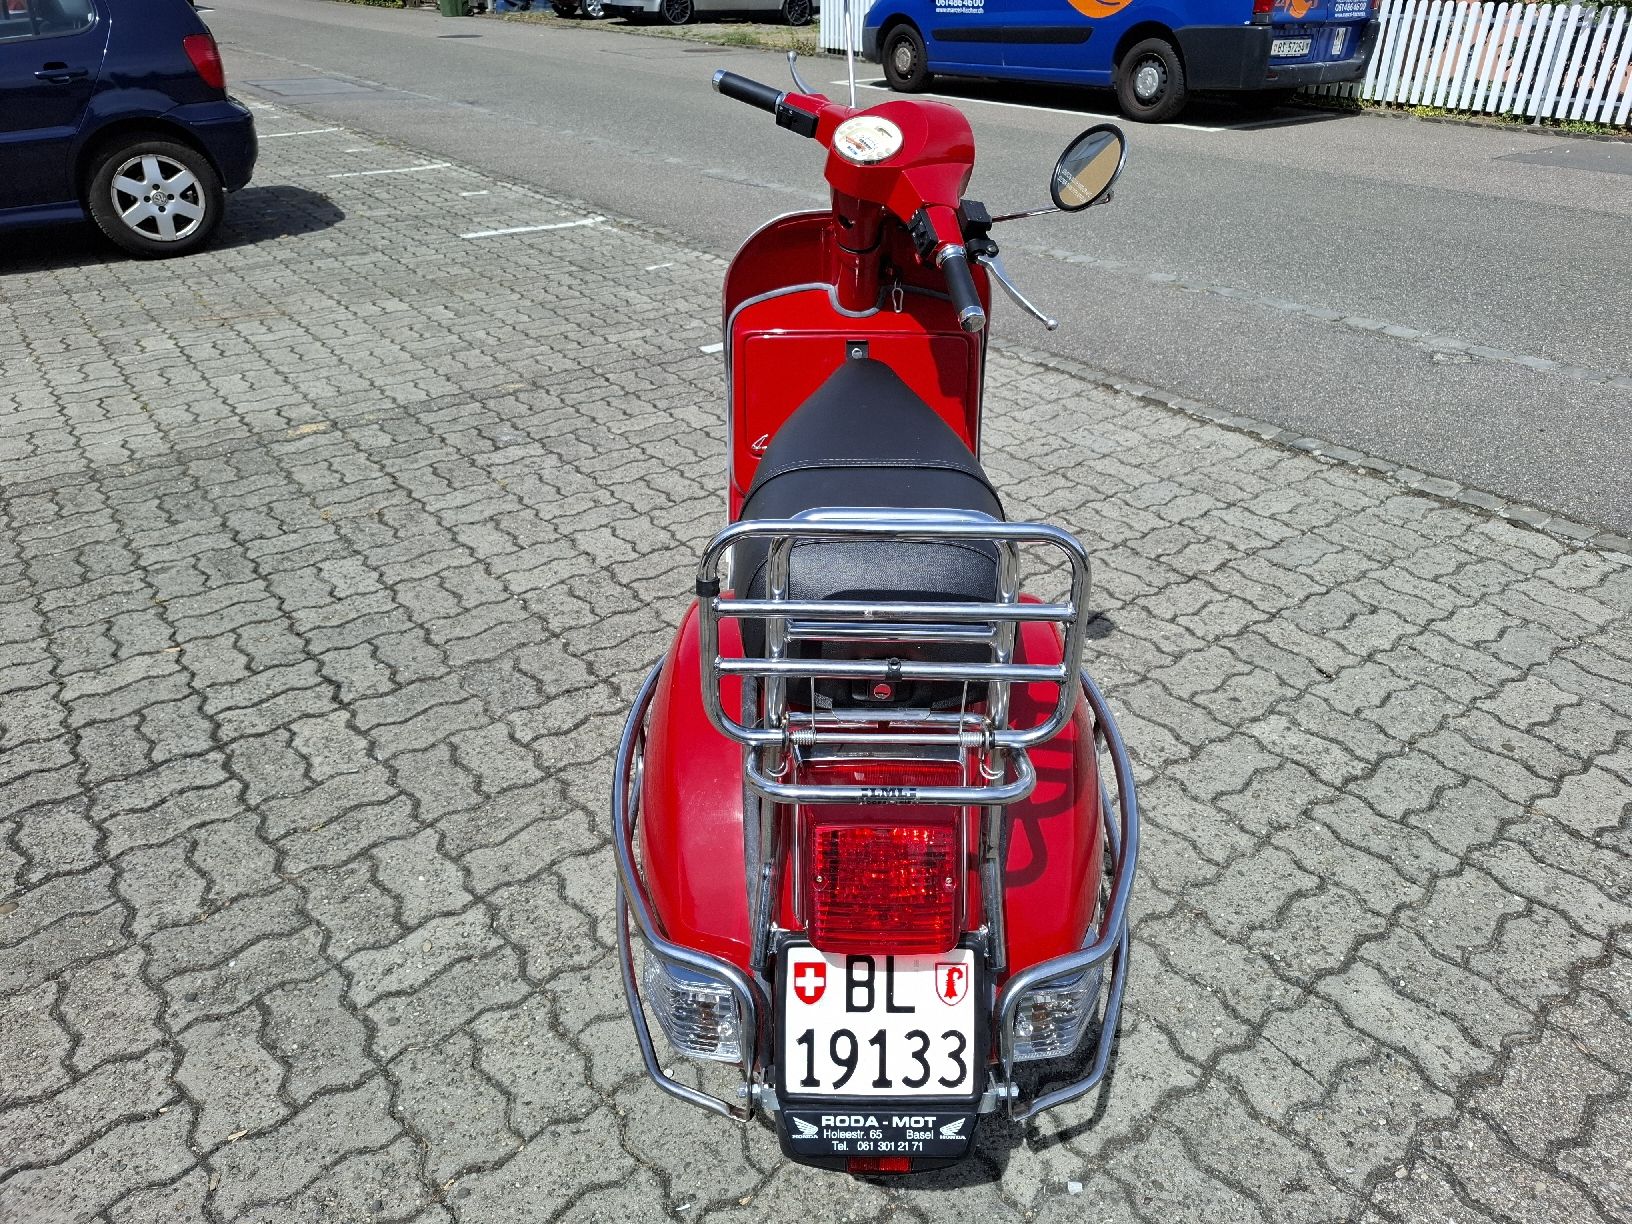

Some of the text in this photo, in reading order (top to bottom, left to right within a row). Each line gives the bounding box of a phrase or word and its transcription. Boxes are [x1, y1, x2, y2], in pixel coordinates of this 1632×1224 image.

[870, 787, 908, 797] LML
[845, 954, 915, 1013] BL
[796, 1028, 967, 1090] 19133
[821, 1115, 879, 1127] RODA
[892, 1116, 937, 1128] MOT
[823, 1128, 934, 1140] Holeestr. 65 Basel
[831, 1140, 923, 1152] Tel. 061 301 21 71
